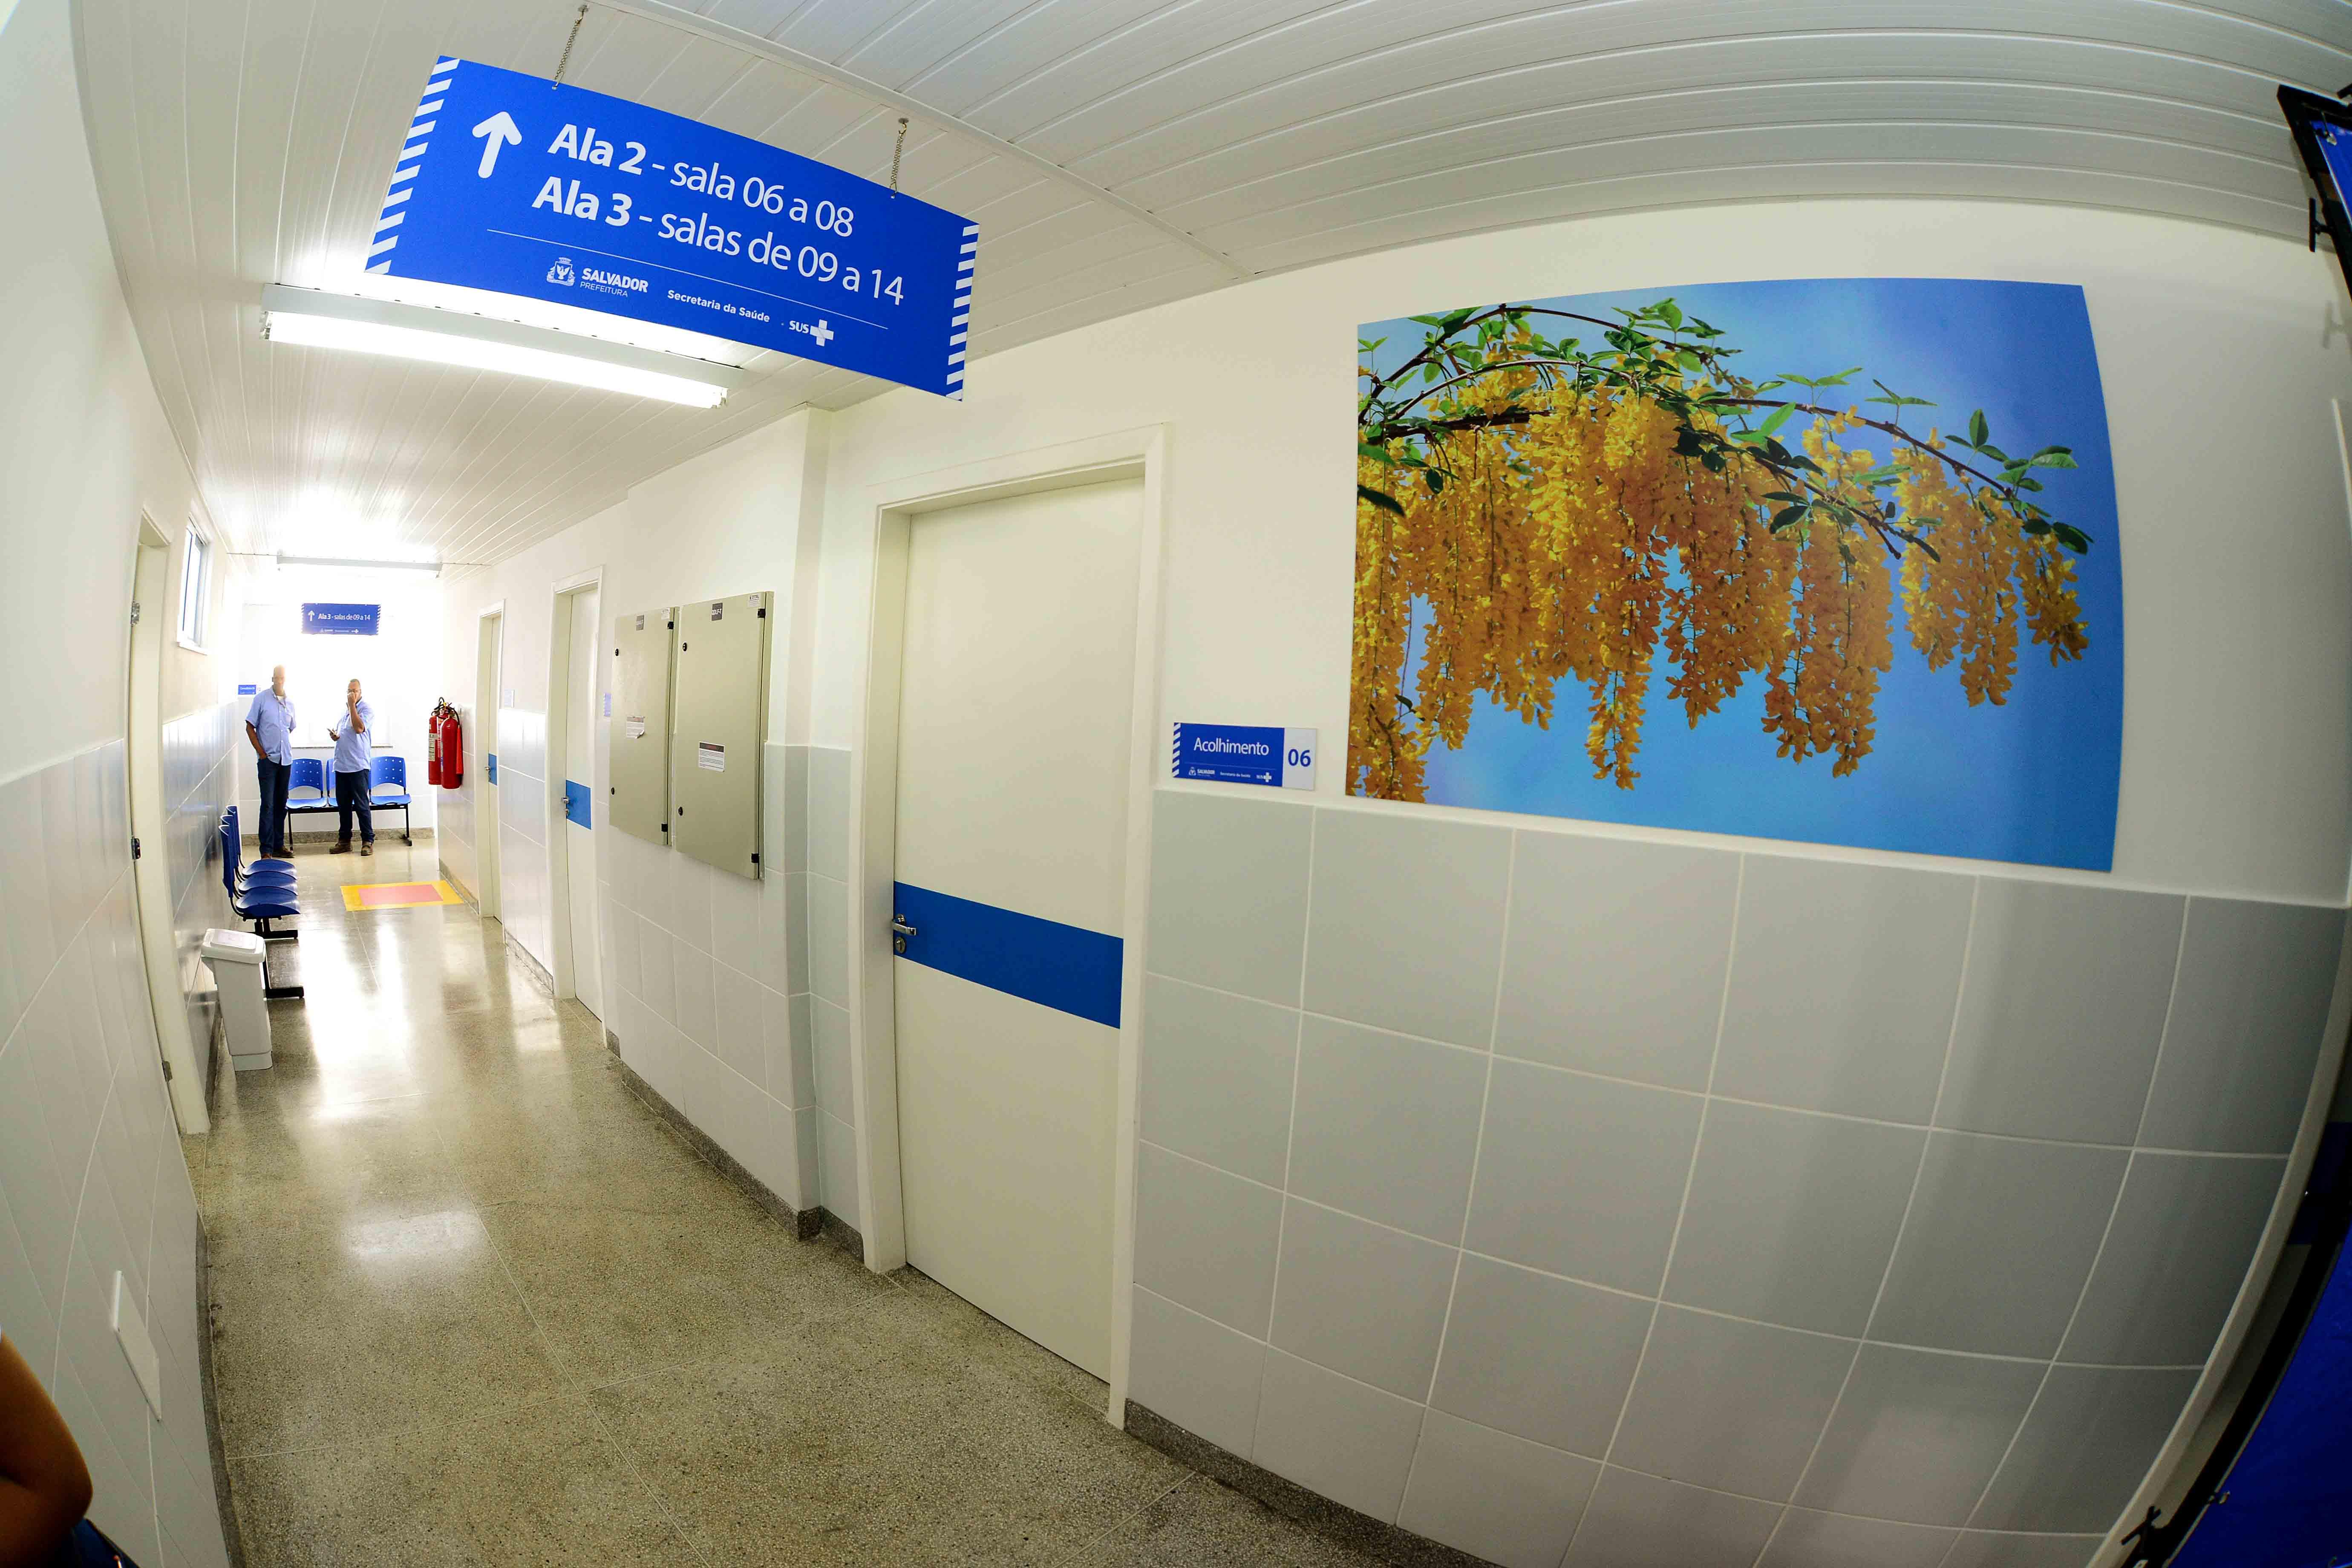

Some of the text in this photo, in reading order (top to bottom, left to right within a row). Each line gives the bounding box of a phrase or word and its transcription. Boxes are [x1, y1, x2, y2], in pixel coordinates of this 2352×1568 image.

[547, 124, 614, 167] Ala
[618, 141, 646, 175] 2
[670, 162, 735, 201] sala
[743, 177, 784, 214] 06
[789, 198, 808, 223] a
[816, 201, 854, 237] 08
[531, 176, 599, 221] Ala
[605, 193, 632, 226] 3
[658, 212, 742, 256] salas
[748, 231, 791, 270] de
[798, 246, 838, 282] 09
[842, 267, 860, 292] a
[872, 269, 904, 305] 14
[580, 281, 628, 297] PREFEITURA
[582, 268, 649, 293] SALVADOR
[667, 290, 770, 322] Secretaria da Saúde
[789, 320, 809, 334] SUS
[1194, 737, 1269, 755] Acolhimento
[1288, 749, 1311, 767] 06
